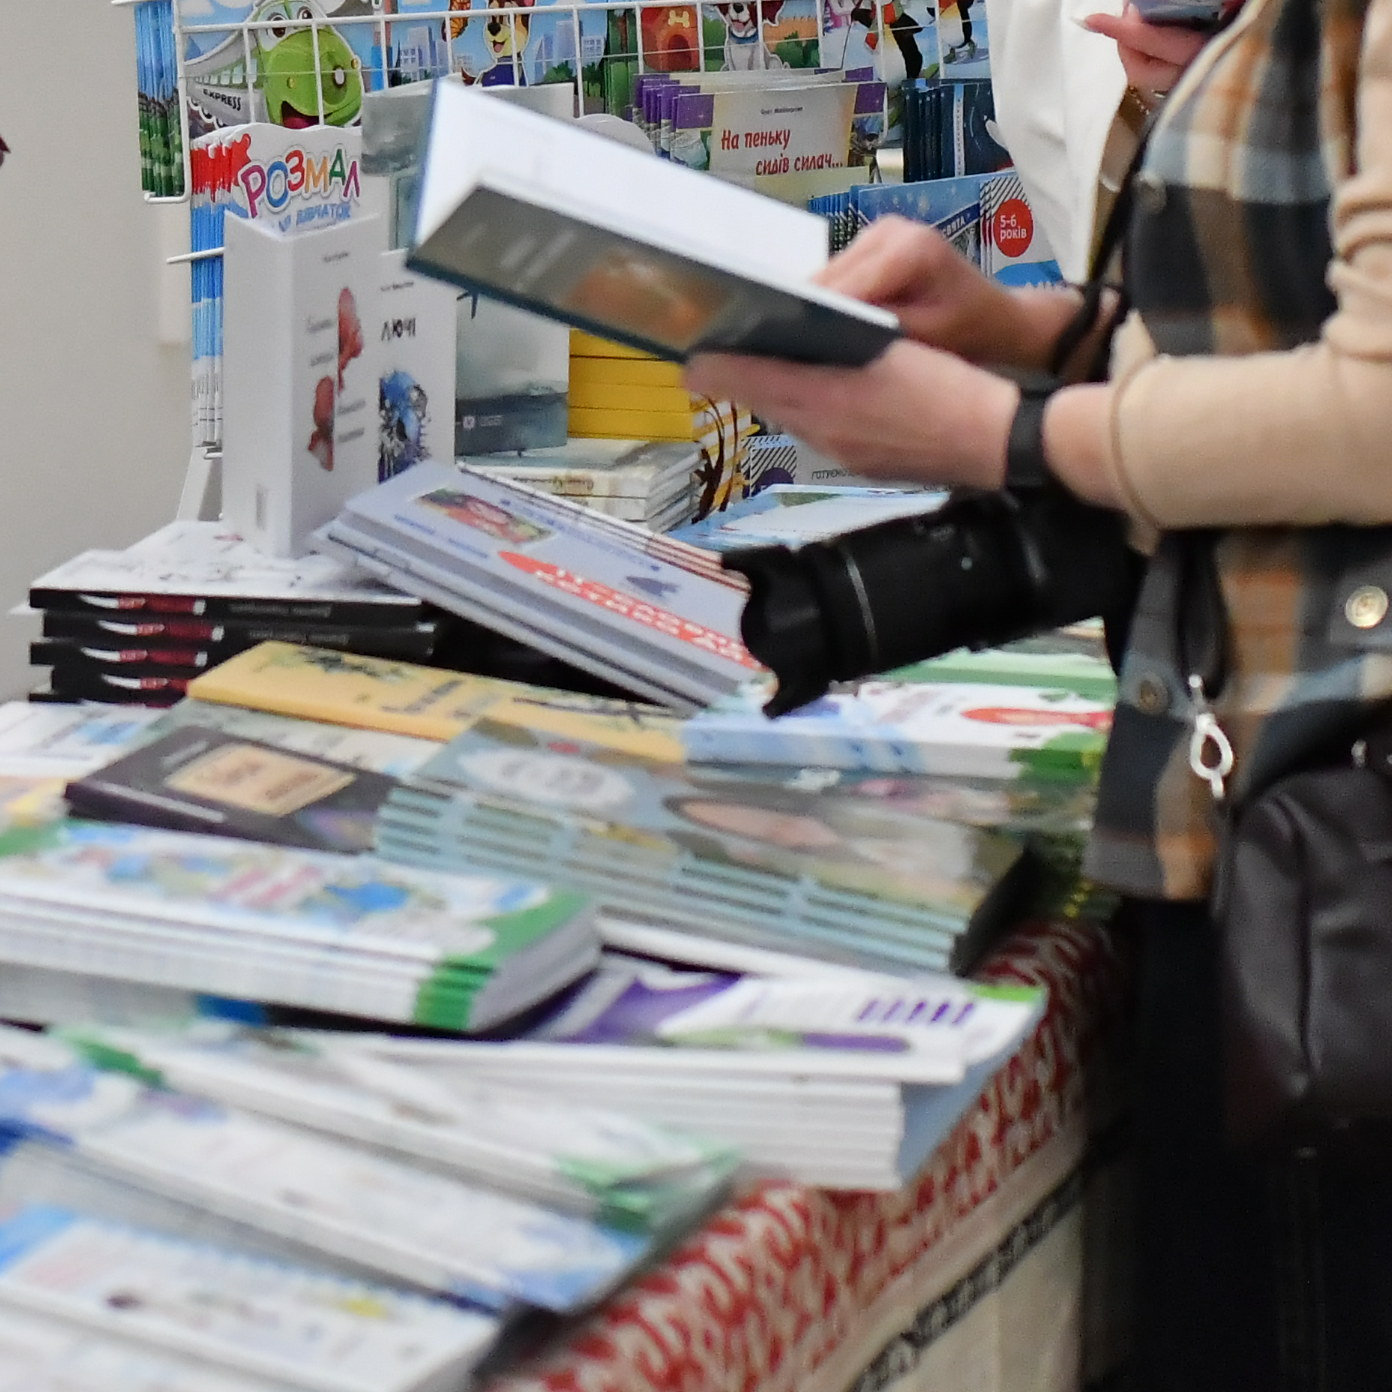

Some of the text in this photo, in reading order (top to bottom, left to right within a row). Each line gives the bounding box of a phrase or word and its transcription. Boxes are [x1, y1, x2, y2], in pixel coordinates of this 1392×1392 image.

[721, 129, 790, 150] На пеньку
[755, 153, 790, 176] сидів
[241, 148, 360, 218] РОЗМАЛ
[1000, 214, 1017, 228] 5-6
[999, 225, 1027, 243] років
